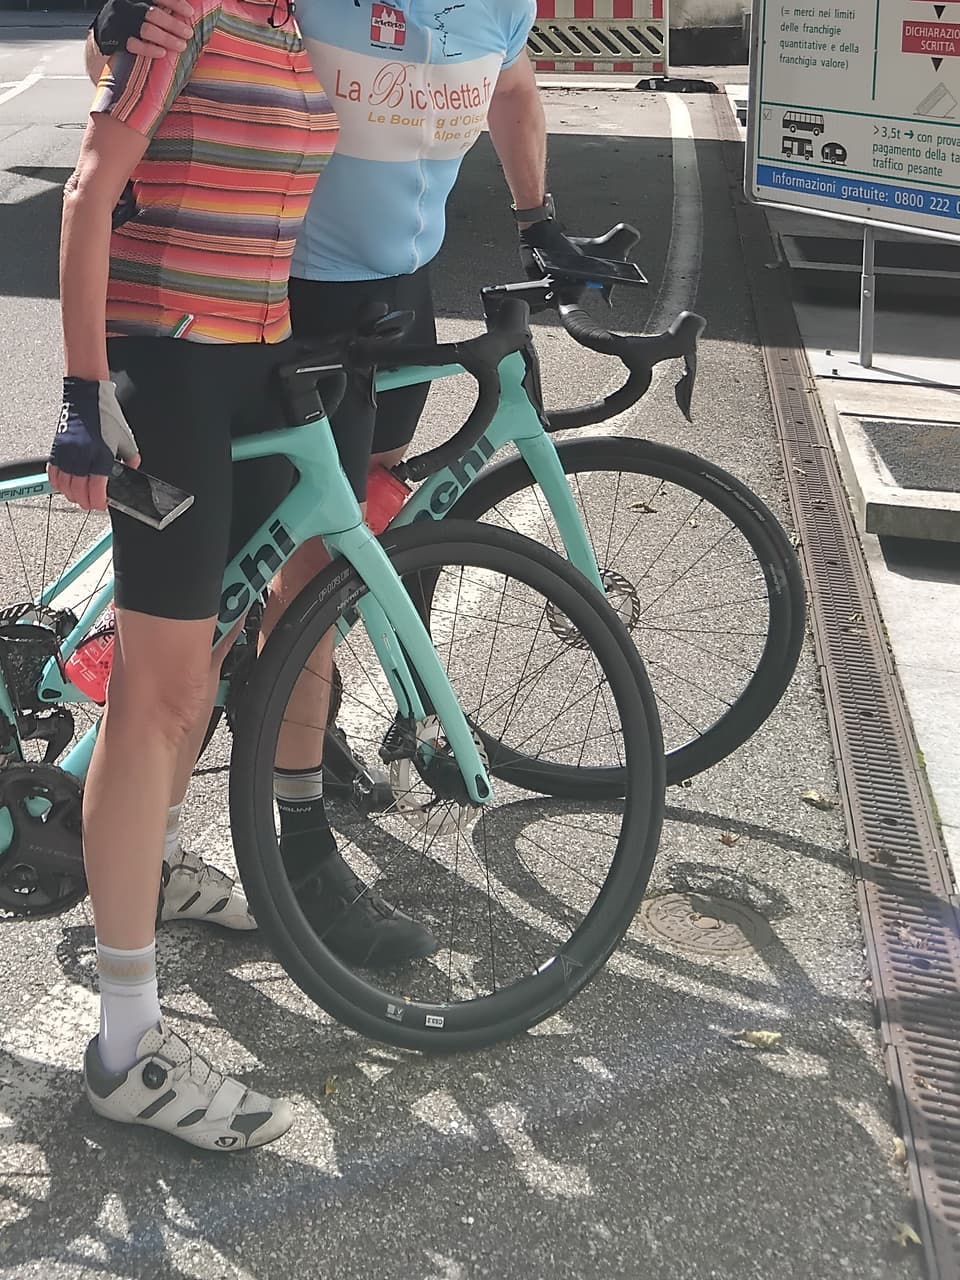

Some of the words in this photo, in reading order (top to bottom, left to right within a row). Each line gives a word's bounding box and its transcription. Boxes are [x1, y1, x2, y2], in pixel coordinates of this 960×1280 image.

[793, 7, 815, 17] merci
[818, 8, 831, 18] nei
[834, 8, 856, 20] limiti
[780, 21, 799, 33] delle
[803, 23, 842, 38] franchigie
[779, 40, 827, 51] quantitative
[830, 43, 836, 52] e
[839, 42, 860, 54] della
[920, 40, 955, 53] SCRITTA
[779, 53, 817, 68] franchigia
[821, 58, 849, 70] valore)
[335, 69, 361, 102] La
[368, 111, 386, 123] Le
[917, 133, 933, 143] con
[872, 143, 921, 156] pagamento
[925, 148, 946, 161] della
[872, 157, 904, 171] traffico
[907, 163, 943, 176] pesante
[772, 171, 836, 193] Informazioni
[841, 184, 889, 202] gratuite:
[894, 191, 924, 208] 0800
[929, 196, 950, 213] 222
